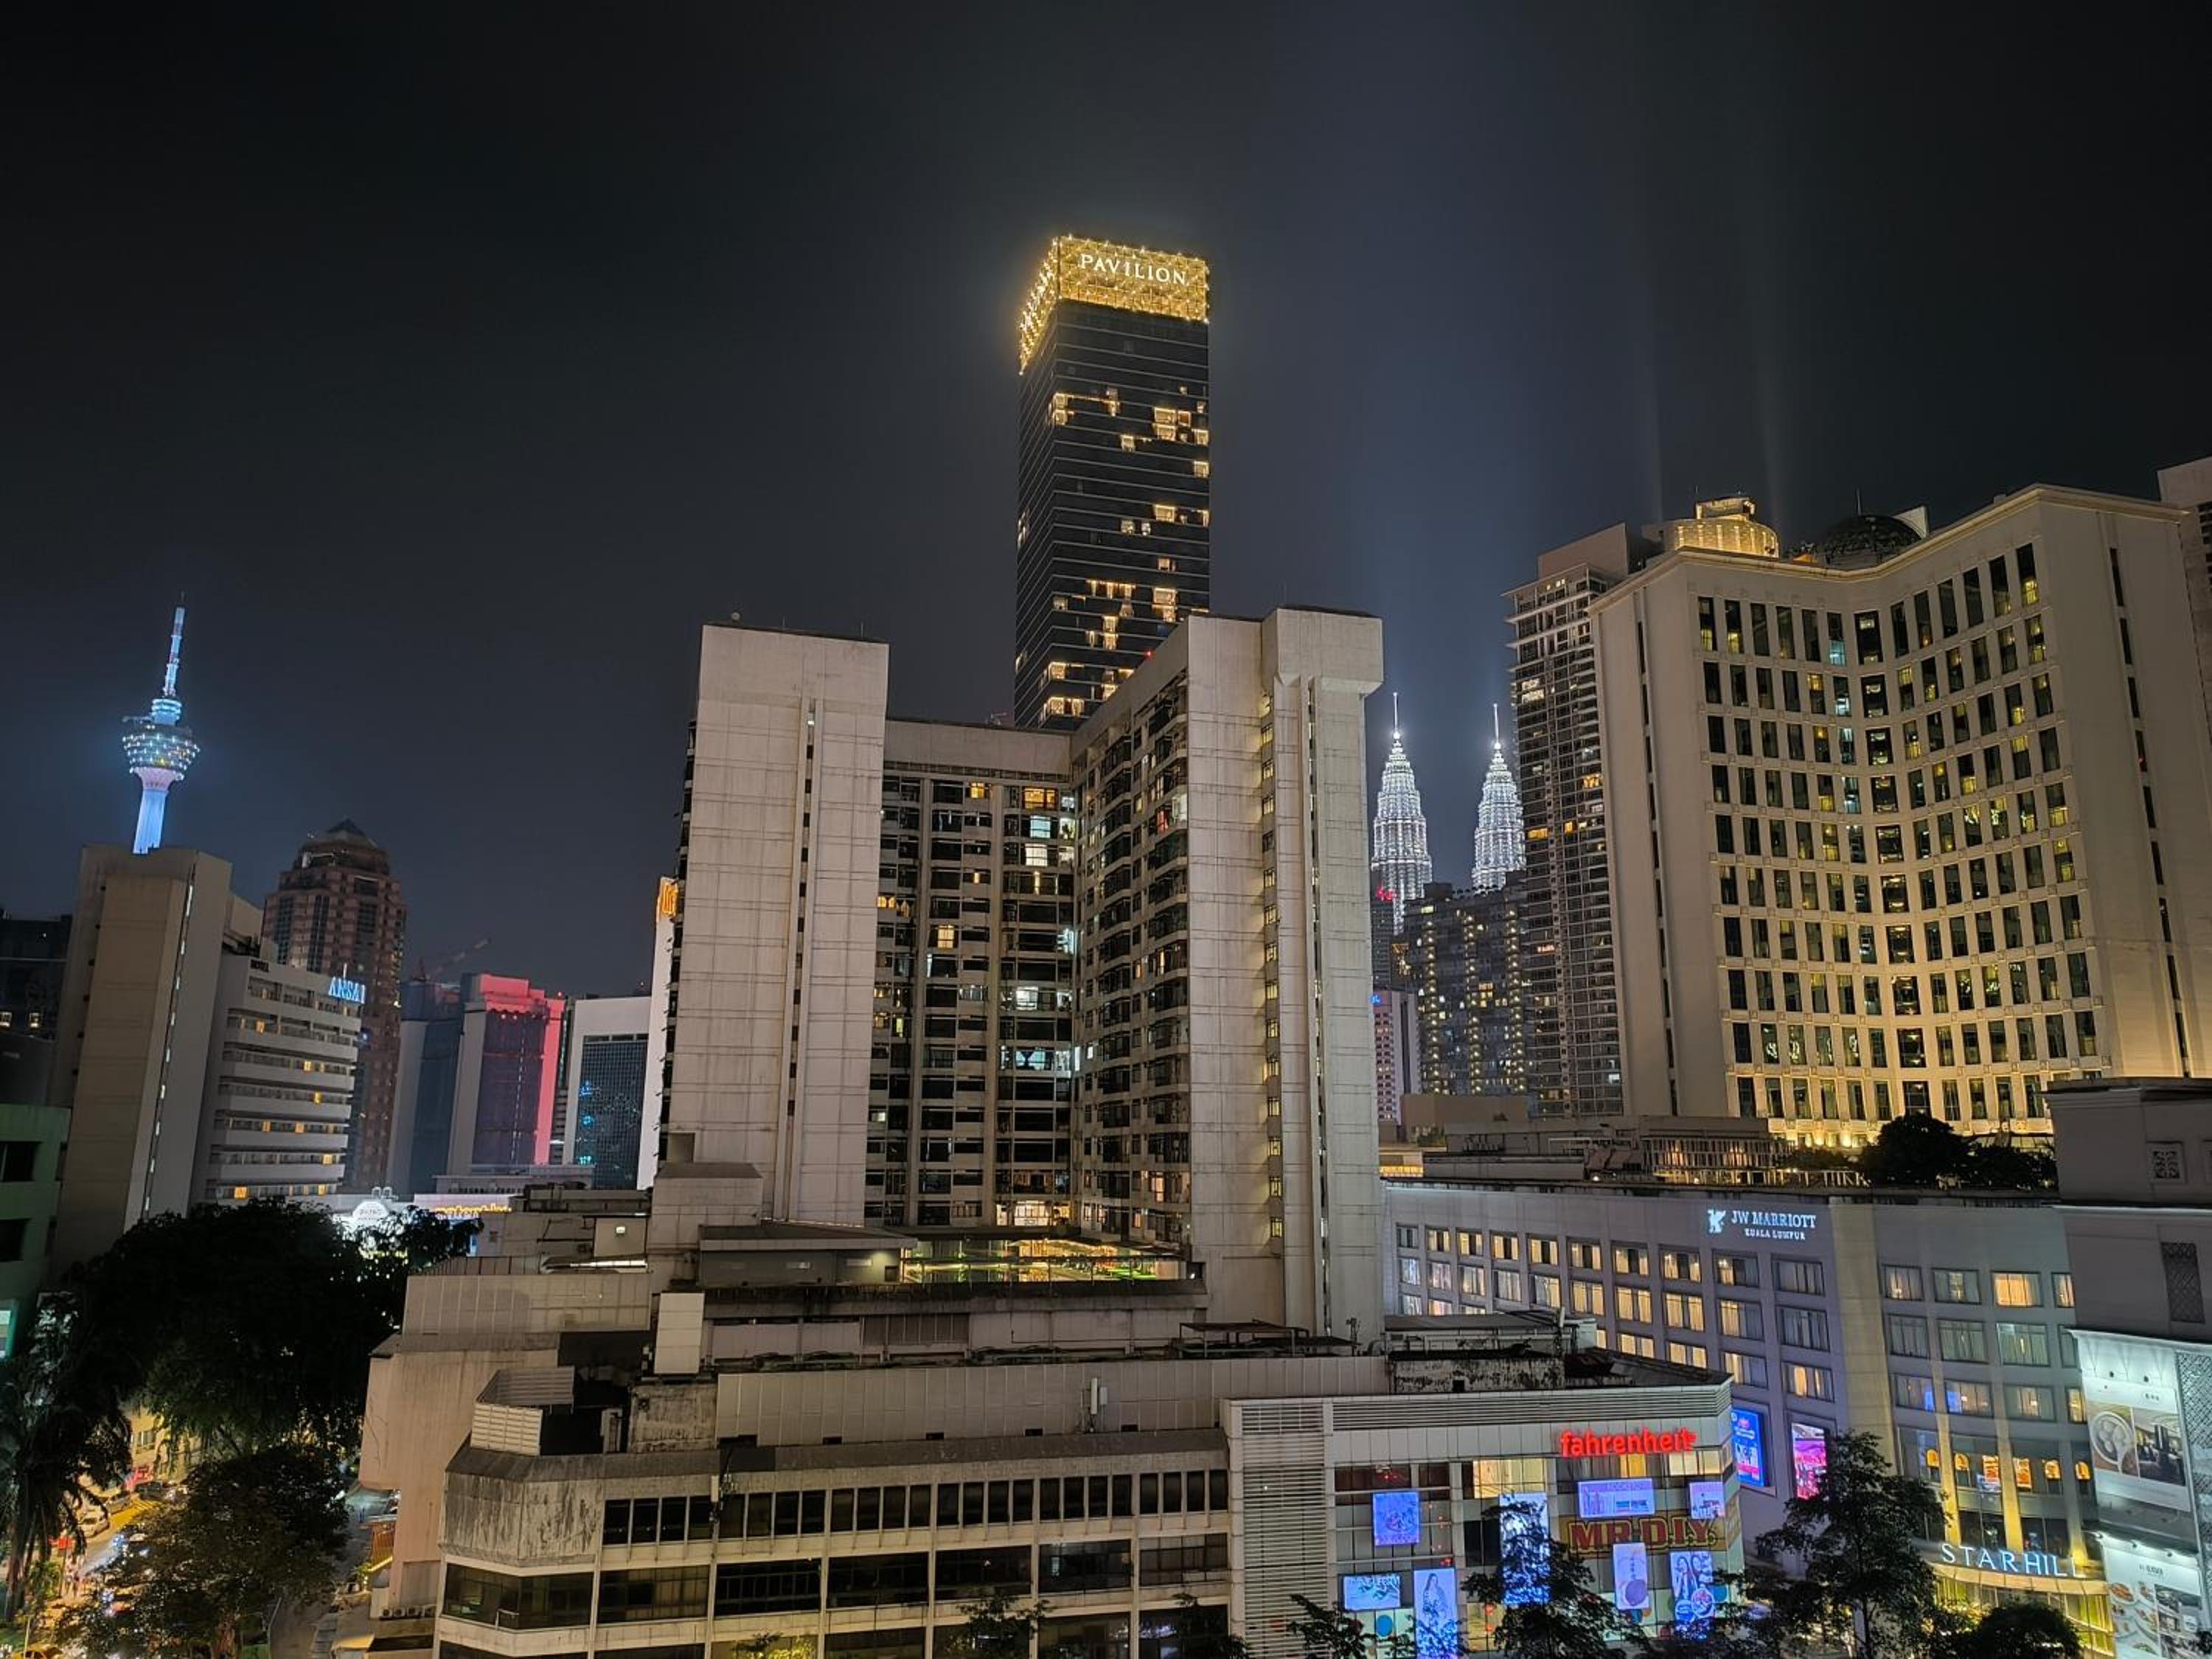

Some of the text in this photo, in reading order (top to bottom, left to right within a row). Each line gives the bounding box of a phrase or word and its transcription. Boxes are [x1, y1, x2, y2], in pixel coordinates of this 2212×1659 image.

[1079, 253, 1186, 285] PAVILION
[1731, 1211, 1816, 1228] JW MARRIOTT
[1745, 1228, 1806, 1240] KUALA LUMPUR
[1561, 1427, 1697, 1458] fahrenheit
[1941, 1543, 2087, 1578] STARHILL
